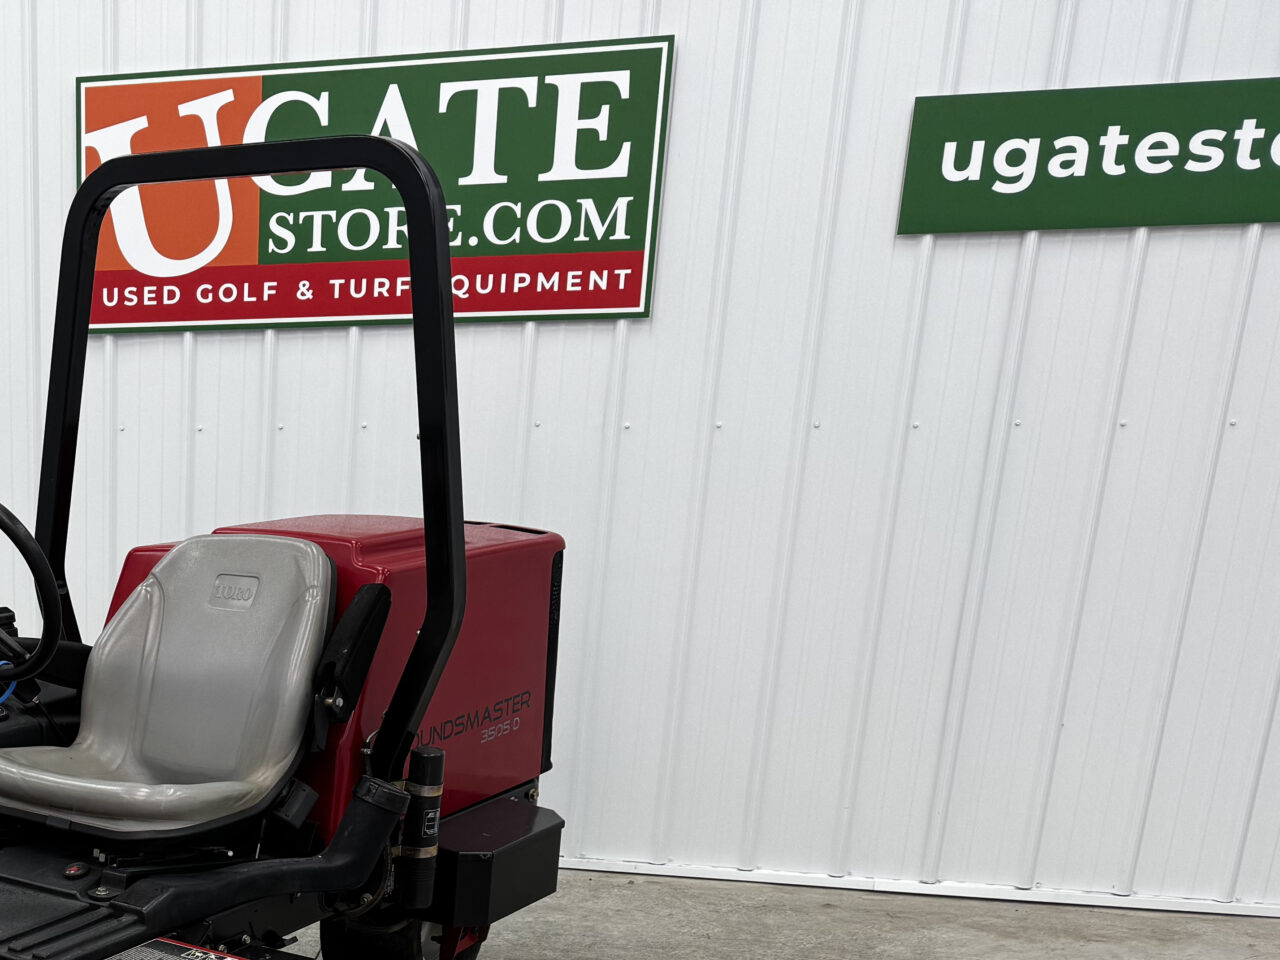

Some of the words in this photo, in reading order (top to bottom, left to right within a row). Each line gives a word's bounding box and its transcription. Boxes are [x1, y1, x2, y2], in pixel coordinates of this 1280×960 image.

[941, 118, 1280, 194] ugatest
[102, 285, 181, 307] USED
[196, 282, 277, 304] GOLF
[296, 280, 314, 301] &
[329, 277, 412, 299] TURF
[451, 268, 633, 299] QUIPMENT
